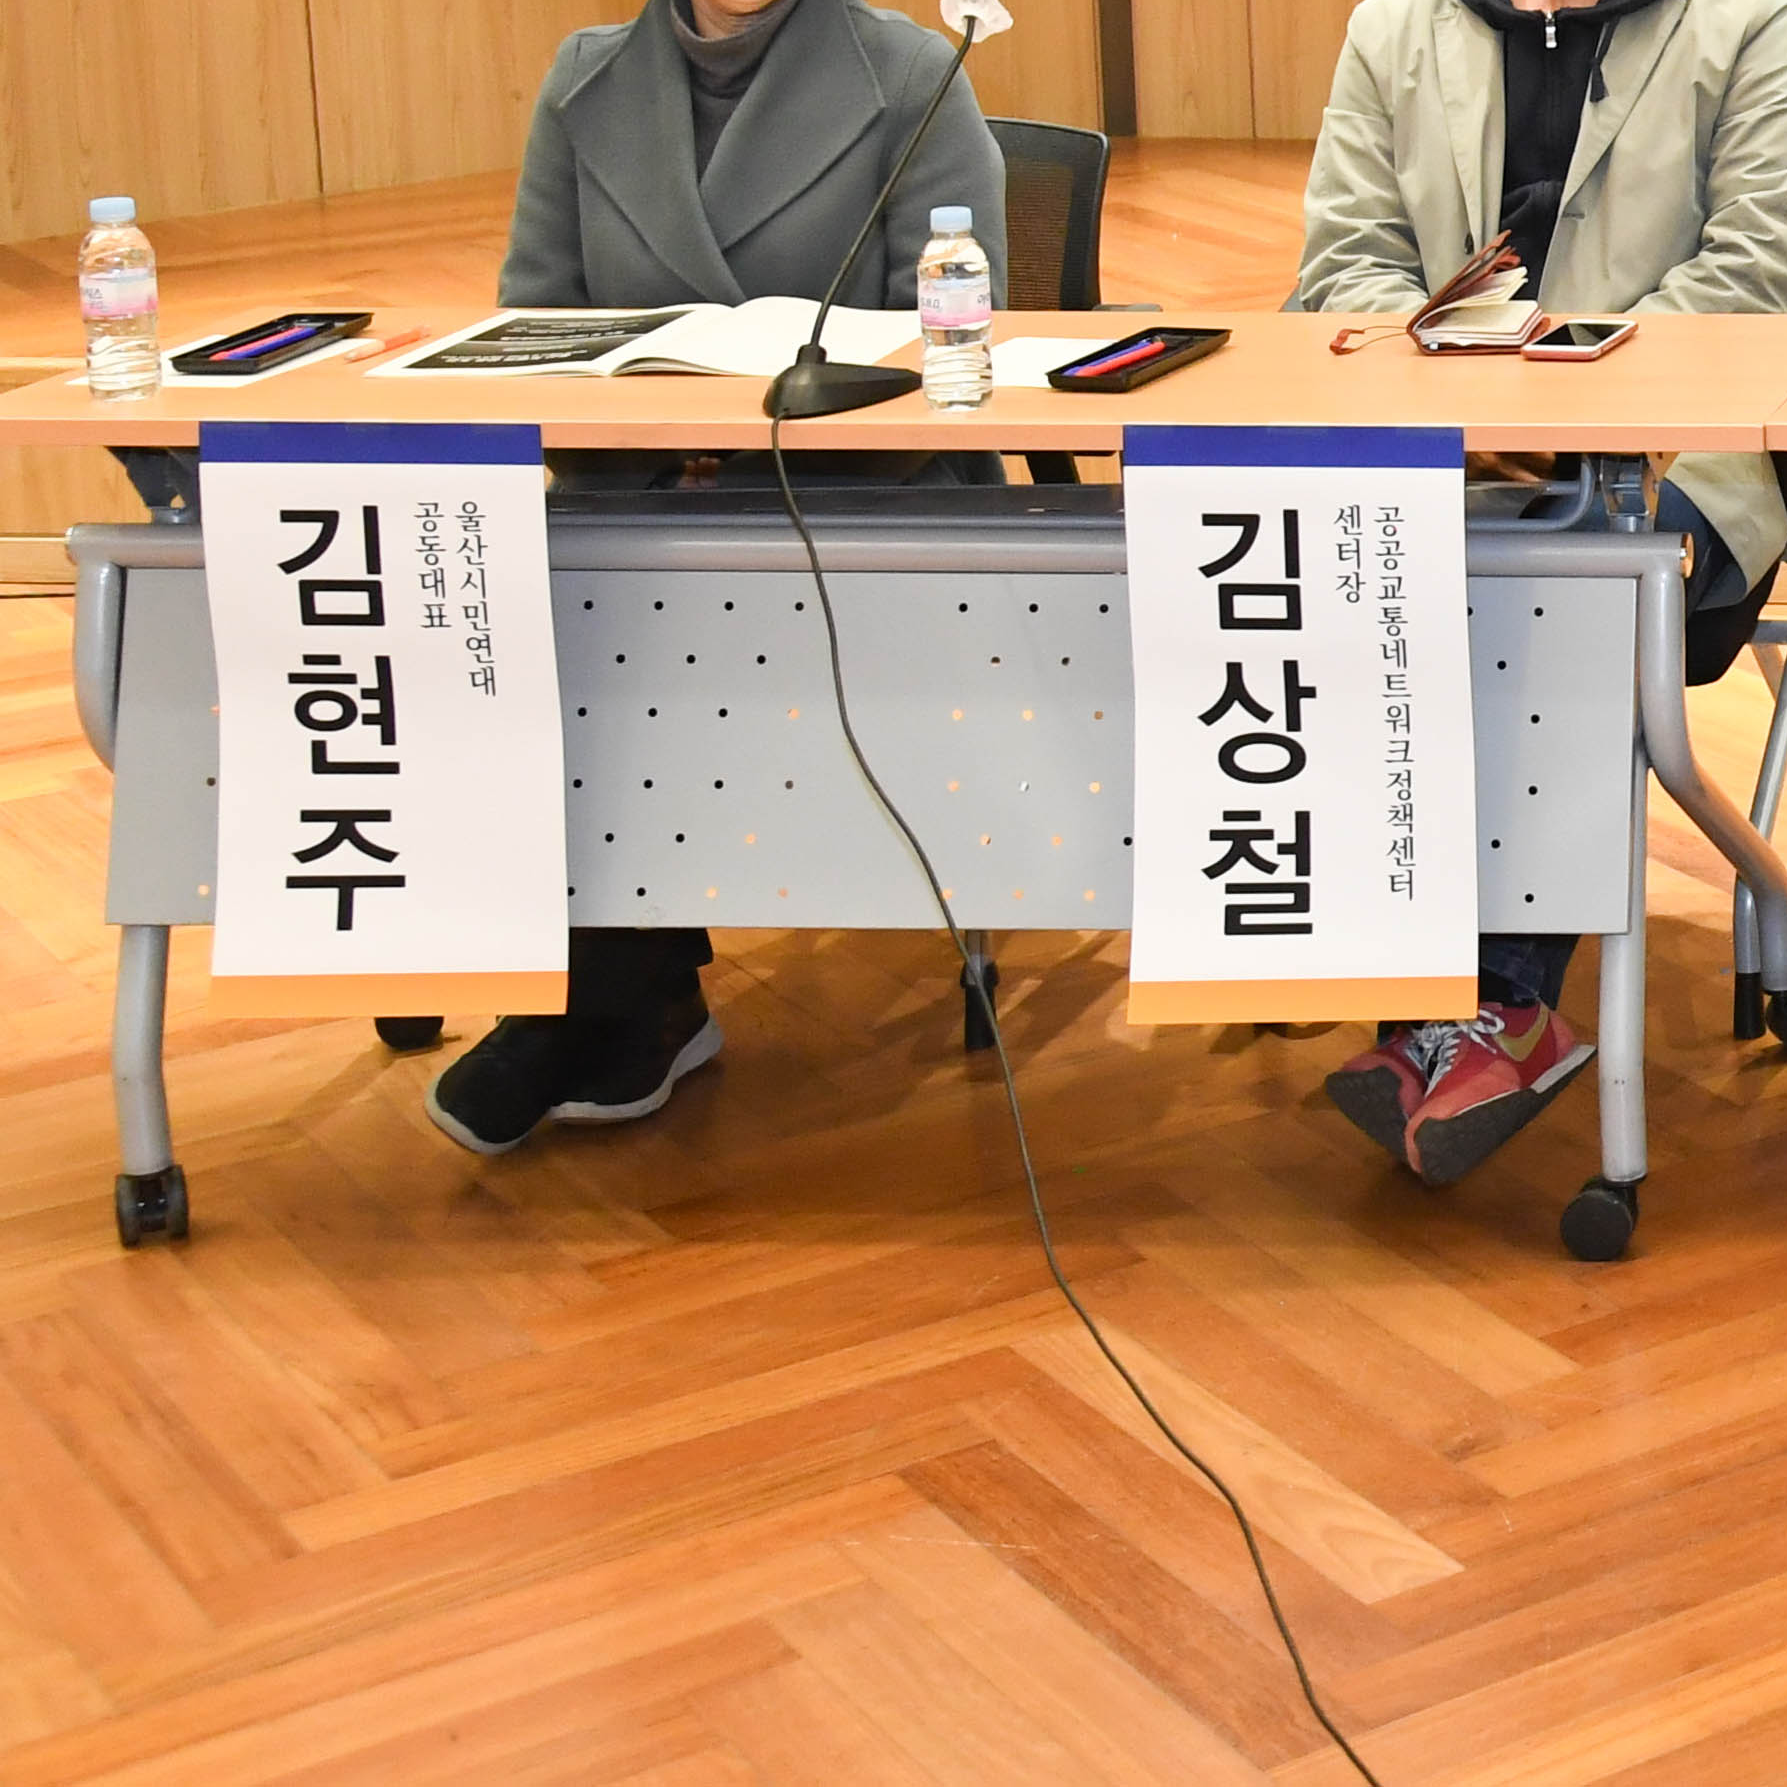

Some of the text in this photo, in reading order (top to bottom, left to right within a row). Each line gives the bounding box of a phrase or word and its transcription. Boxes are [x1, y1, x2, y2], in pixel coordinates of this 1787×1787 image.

[414, 502, 452, 628] 공동대표
[456, 501, 496, 696] 울산시민연대
[1334, 504, 1366, 603] 센터장
[277, 505, 406, 931] 김현주
[1197, 509, 1317, 936] 김상철
[1375, 507, 1416, 901] 공공교통네트워크정책센터
